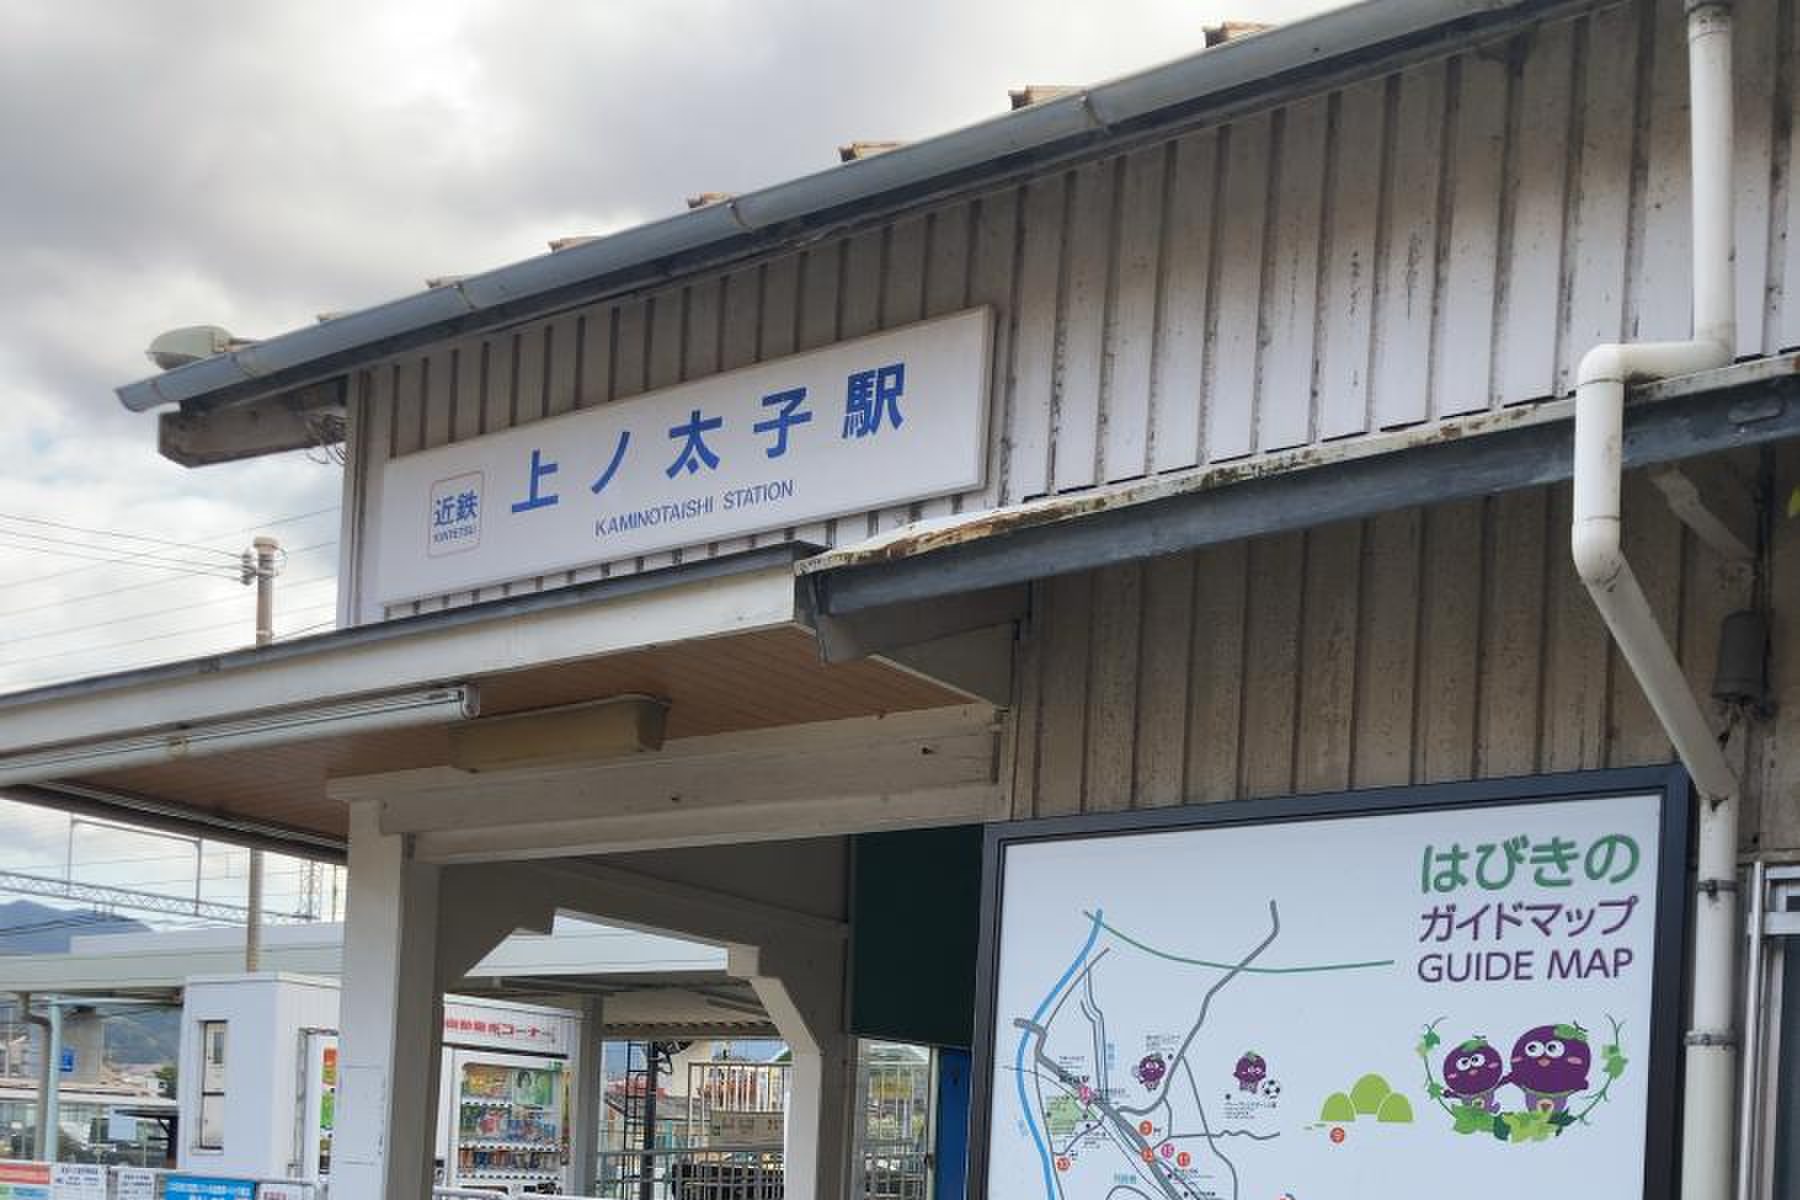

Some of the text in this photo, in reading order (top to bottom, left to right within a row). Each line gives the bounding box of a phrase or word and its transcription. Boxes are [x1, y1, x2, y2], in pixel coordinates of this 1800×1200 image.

[510, 362, 906, 514] 上ノ太子駅
[434, 489, 478, 526] 近鉄
[594, 479, 794, 538] KAMINOTAISHI STATION
[1421, 834, 1640, 894] はびきの
[1419, 895, 1639, 942] ガイドマップ
[1417, 948, 1634, 982] GUIDE MAP
